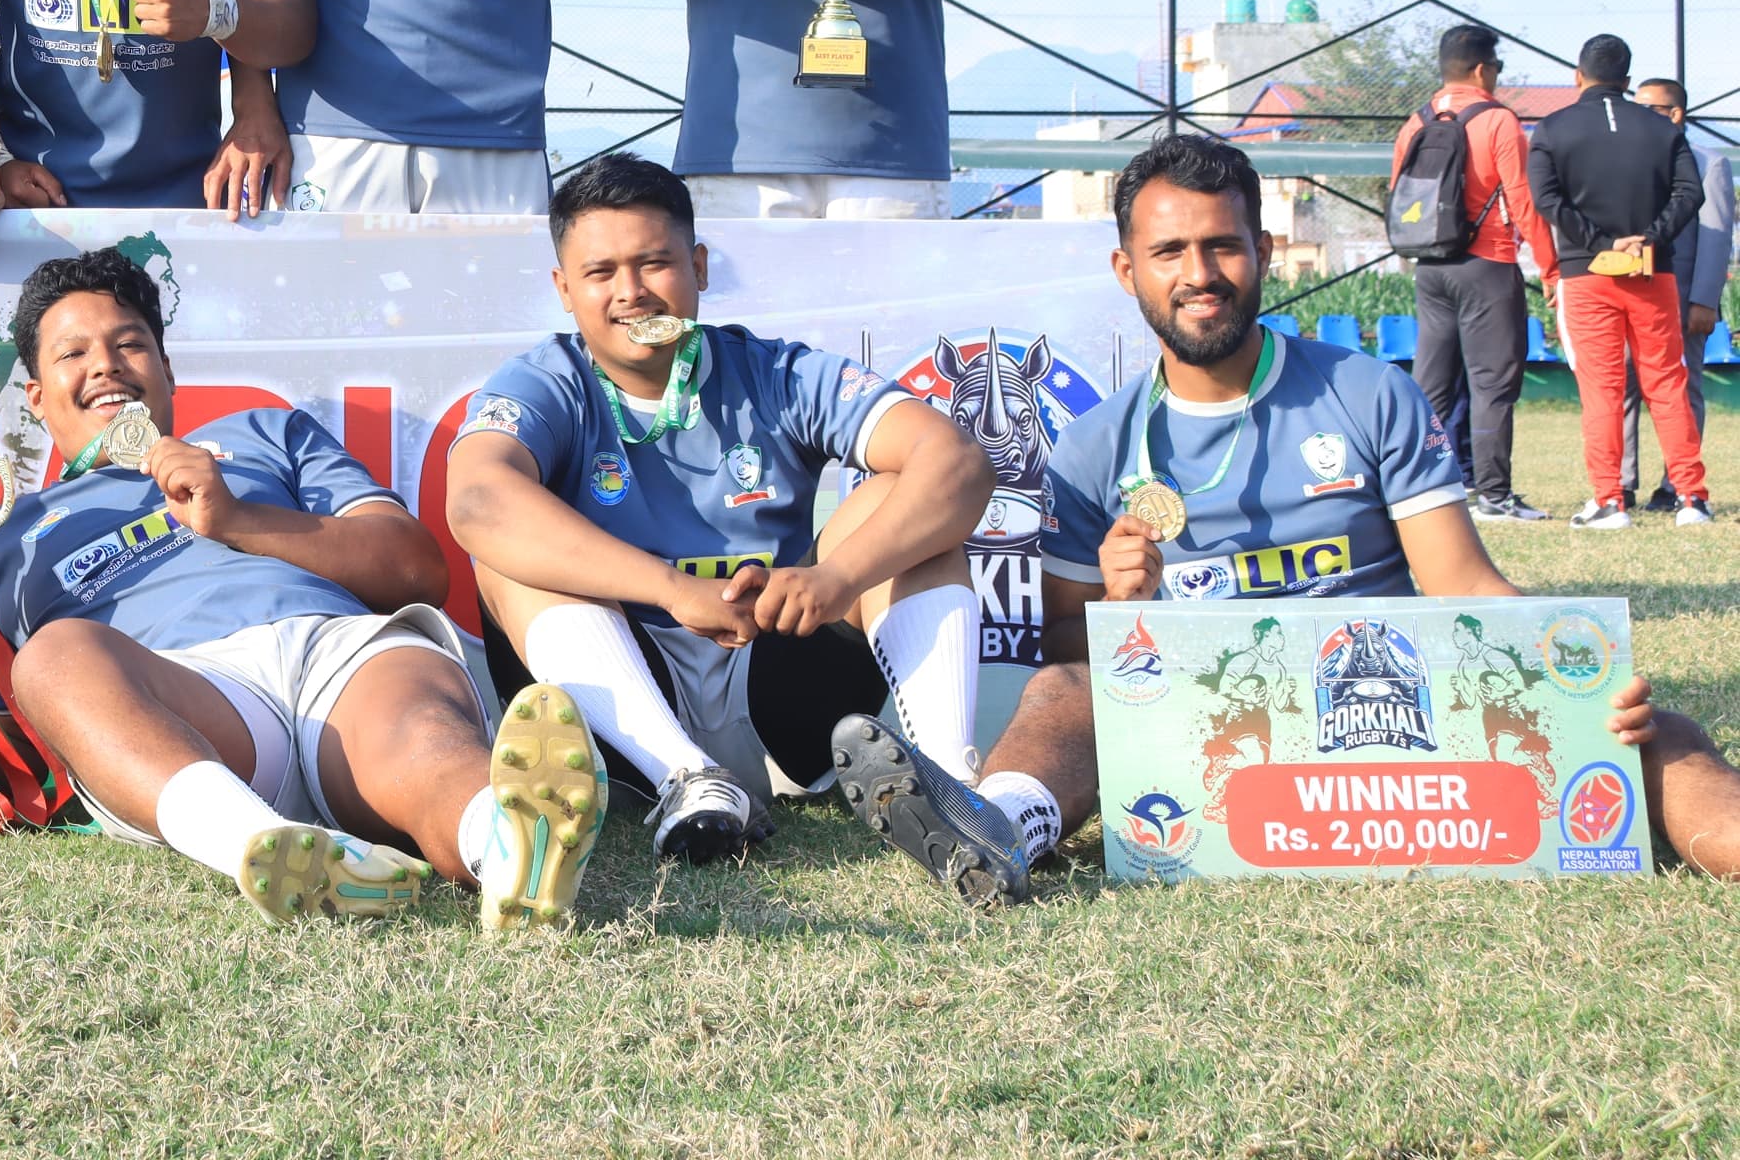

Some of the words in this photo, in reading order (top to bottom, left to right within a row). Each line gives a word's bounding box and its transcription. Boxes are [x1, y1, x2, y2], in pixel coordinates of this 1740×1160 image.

[1245, 543, 1343, 588] LIC
[1319, 702, 1437, 748] GORKHALI
[1345, 731, 1389, 748] RUGBY
[1294, 775, 1470, 812] WINNER
[1264, 822, 1319, 854] Rs.
[1329, 817, 1508, 857] 2,00,000/-
[1561, 850, 1597, 861] NEPAL
[1600, 850, 1637, 861] RUGBY
[1563, 860, 1636, 871] ASSOCIATION
